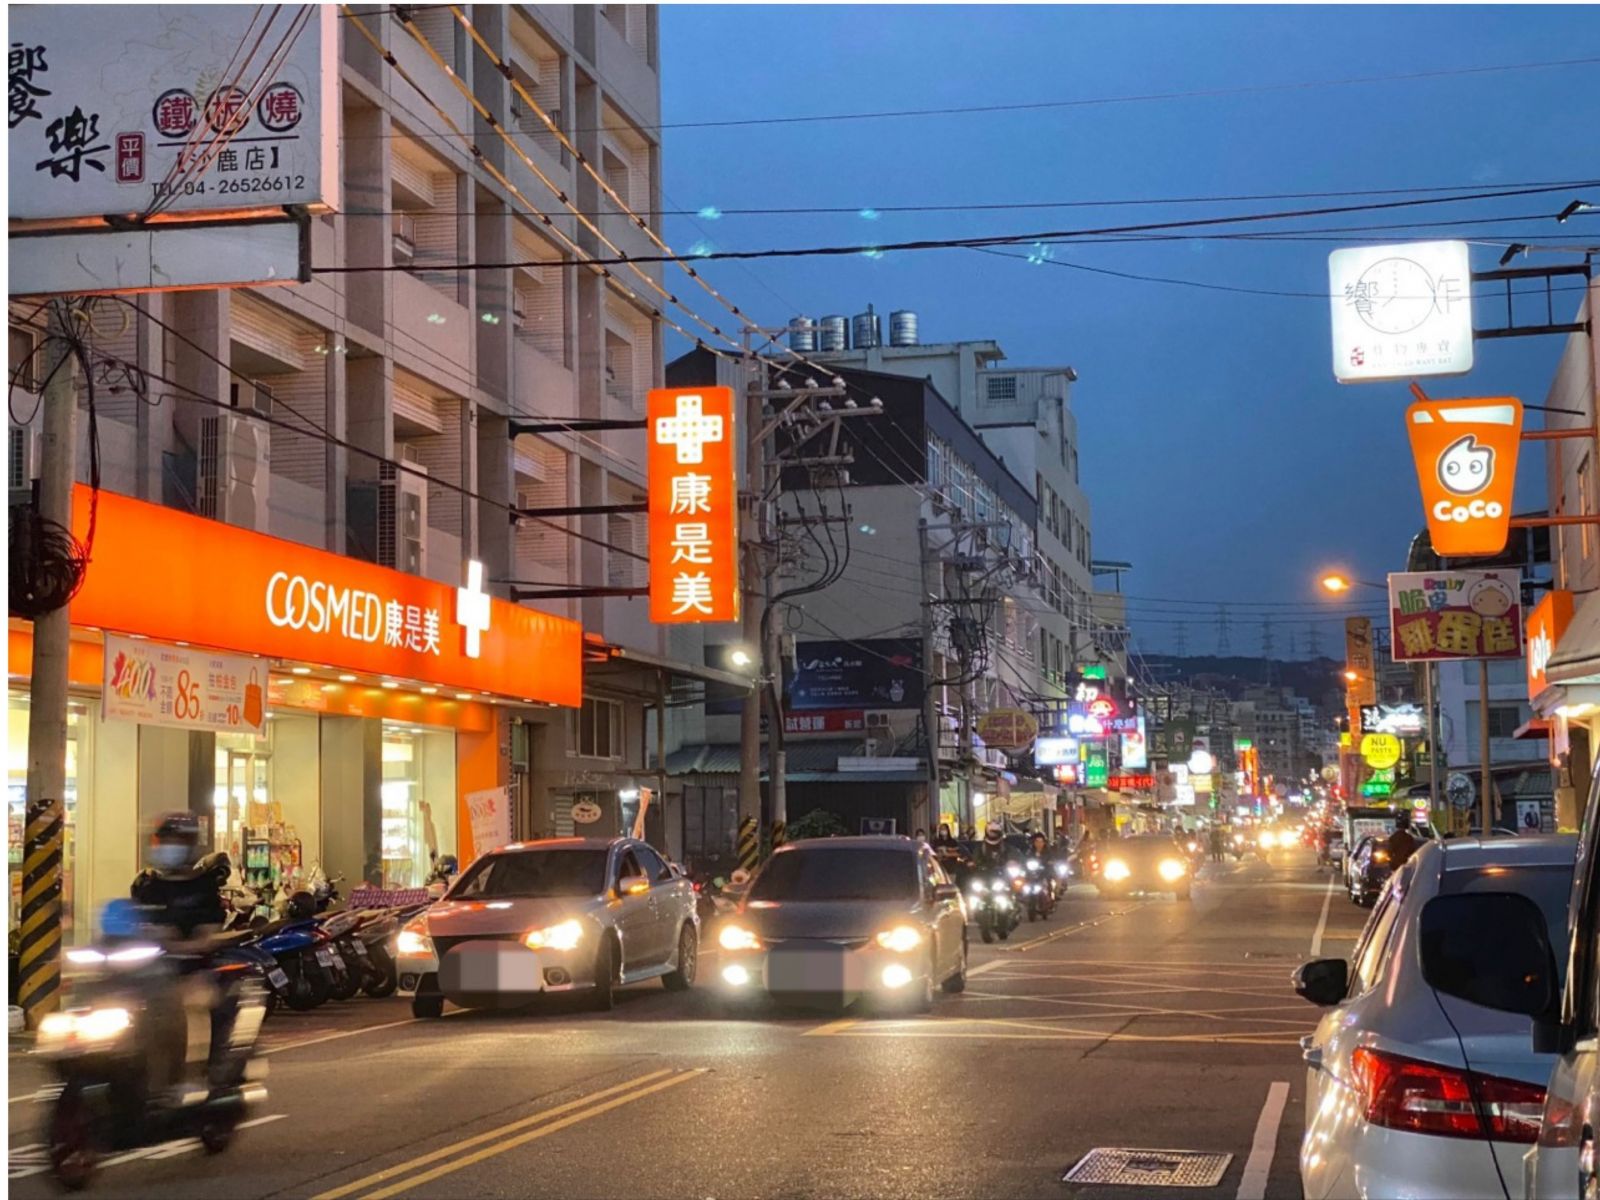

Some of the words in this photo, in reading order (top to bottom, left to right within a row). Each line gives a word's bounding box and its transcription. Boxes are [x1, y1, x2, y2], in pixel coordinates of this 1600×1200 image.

[159, 90, 298, 132] 鐵板燒
[121, 138, 140, 177] 平價
[670, 472, 713, 615] 康是美
[266, 572, 381, 642] COSMED
[384, 599, 440, 655] 康是美
[1398, 610, 1517, 656] 雞蛋糕
[174, 669, 199, 719] 85
[226, 704, 239, 725] 10
[1371, 738, 1387, 747] NU
